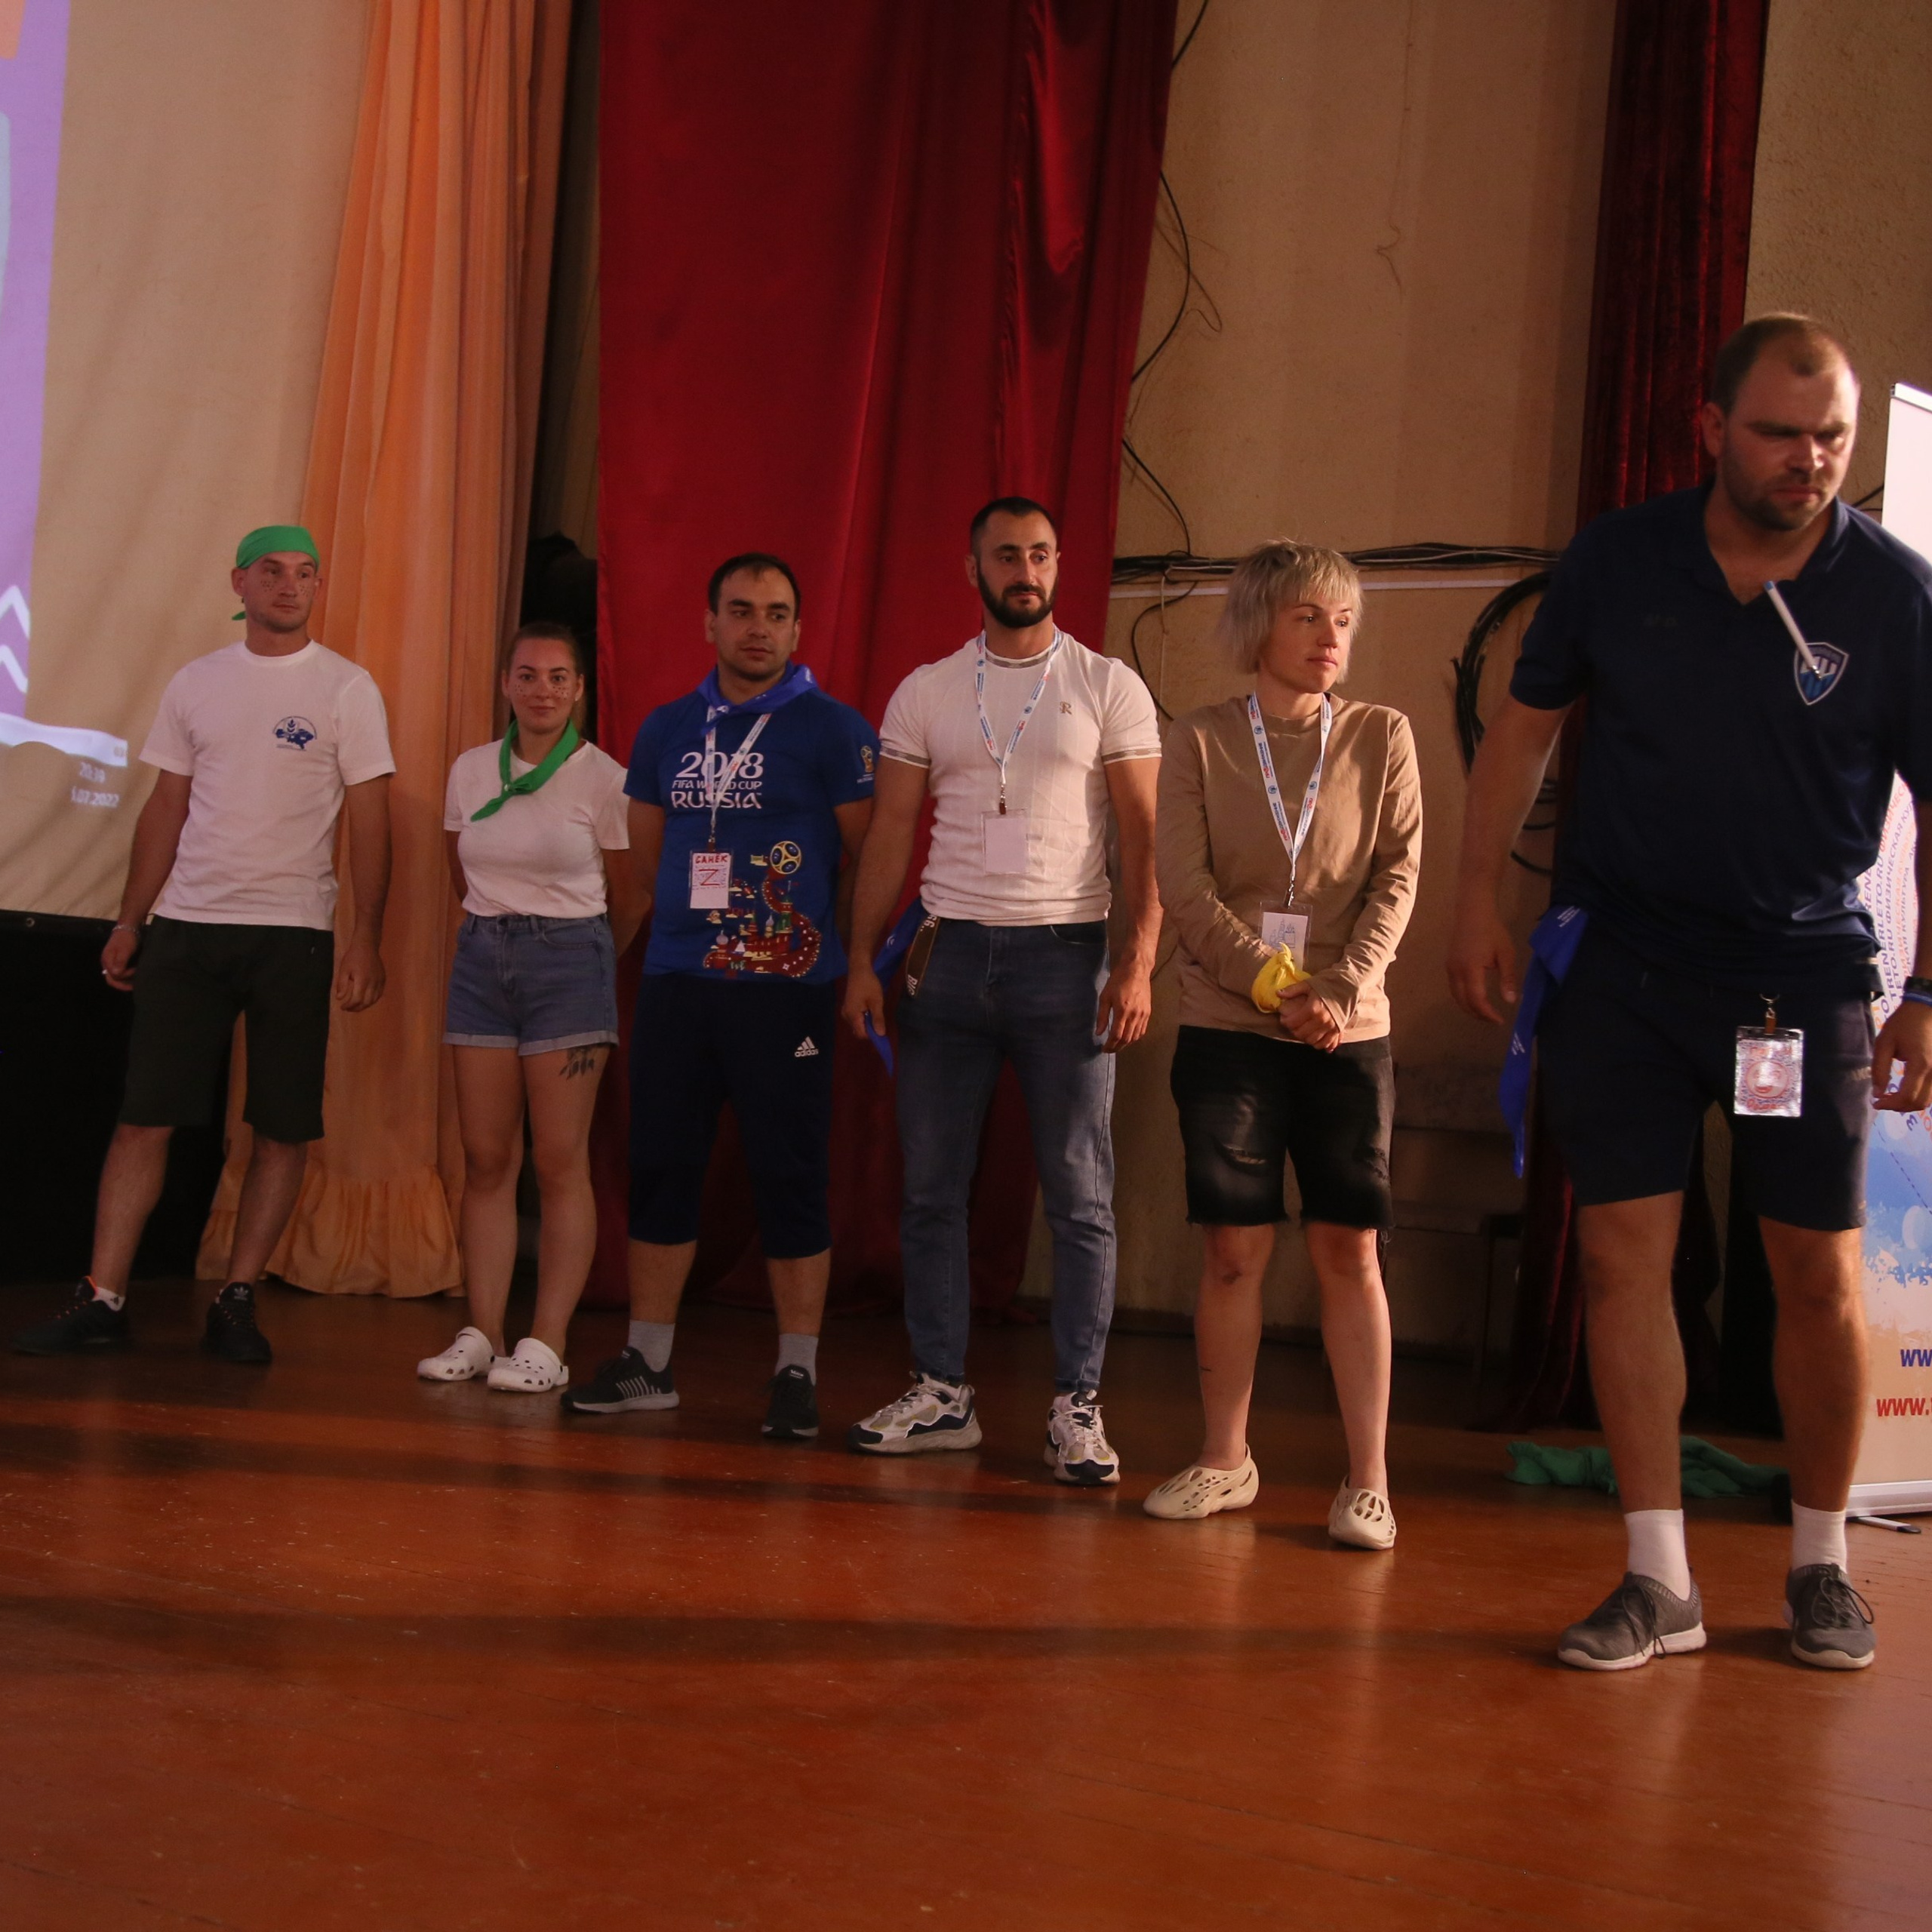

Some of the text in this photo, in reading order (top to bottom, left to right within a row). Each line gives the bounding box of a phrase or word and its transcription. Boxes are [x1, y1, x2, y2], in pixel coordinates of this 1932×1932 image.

[672, 780, 694, 789] FIFA
[737, 780, 762, 790] CUP
[699, 869, 719, 885] Z
